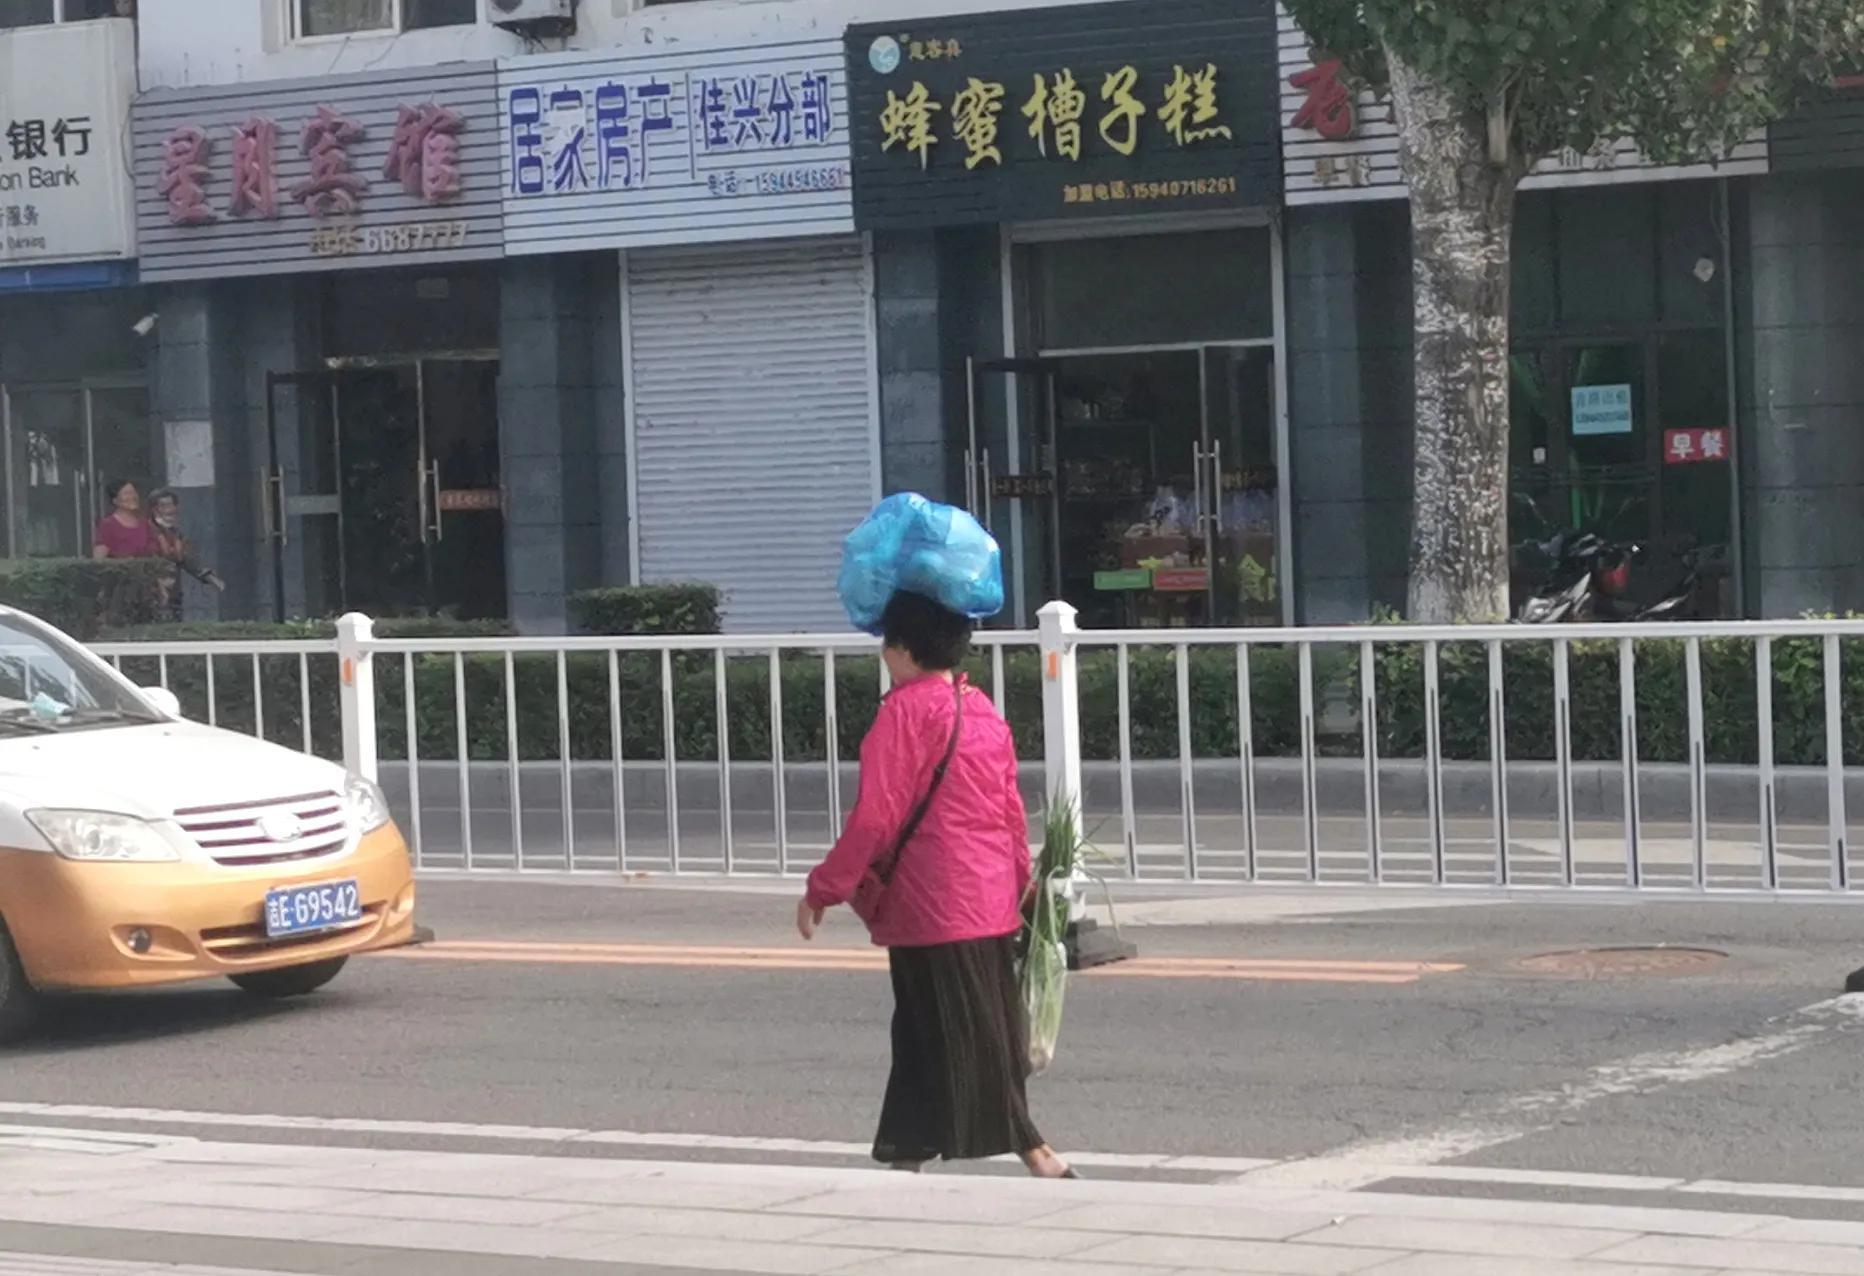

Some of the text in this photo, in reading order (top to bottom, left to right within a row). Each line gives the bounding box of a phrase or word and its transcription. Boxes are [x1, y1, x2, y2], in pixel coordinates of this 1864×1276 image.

[509, 78, 673, 195] 居家房产
[702, 70, 829, 150] 佳兴分部
[880, 63, 1233, 170] 蜂蜜槽子糕
[28, 164, 79, 189] Bank
